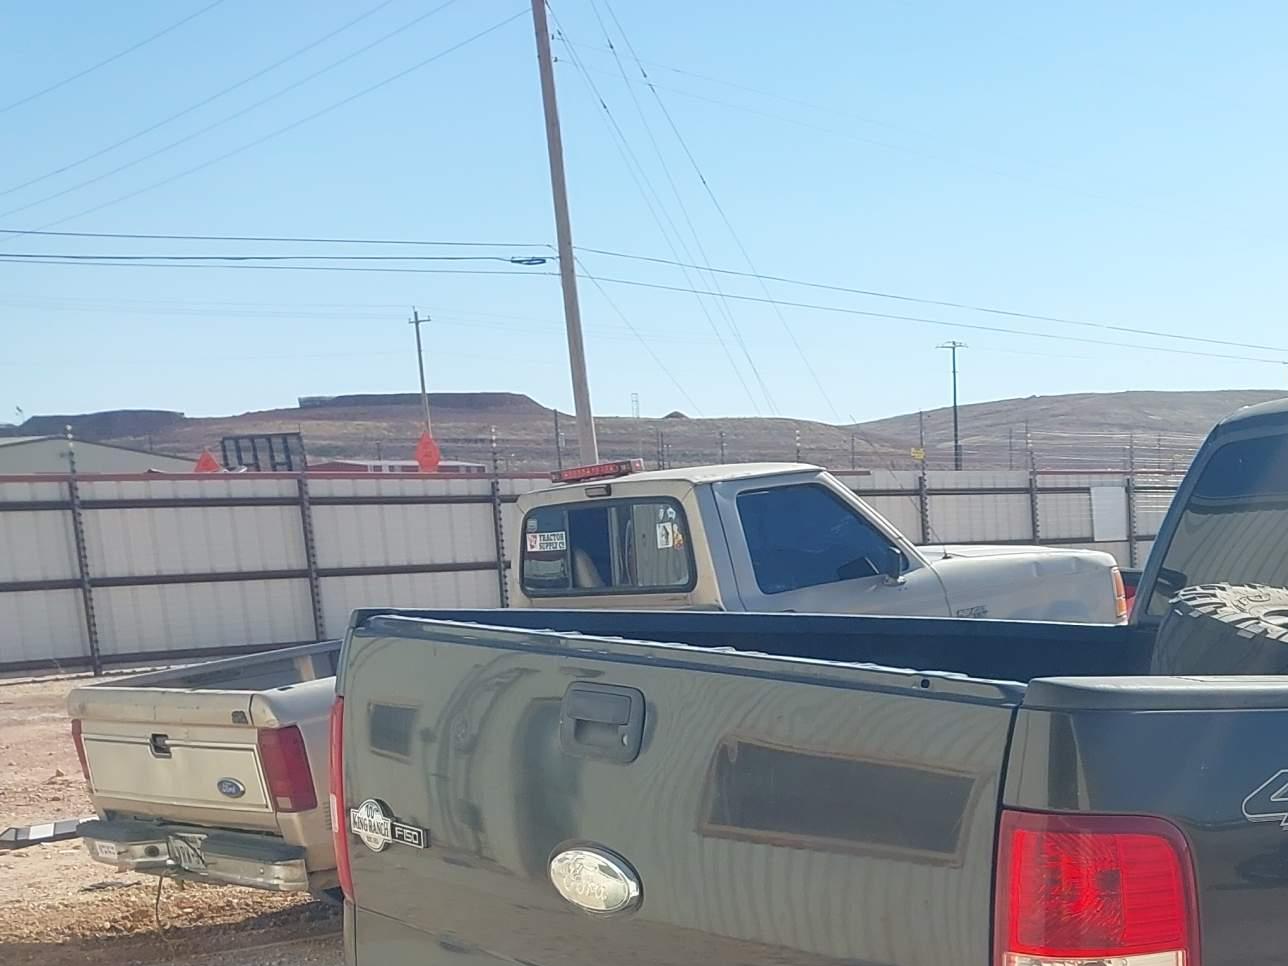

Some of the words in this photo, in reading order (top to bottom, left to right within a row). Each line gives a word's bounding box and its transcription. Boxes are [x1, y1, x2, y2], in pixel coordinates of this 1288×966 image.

[538, 533, 564, 542] TRACTOR
[538, 542, 558, 550] SUPPLY
[395, 826, 420, 844] F150
